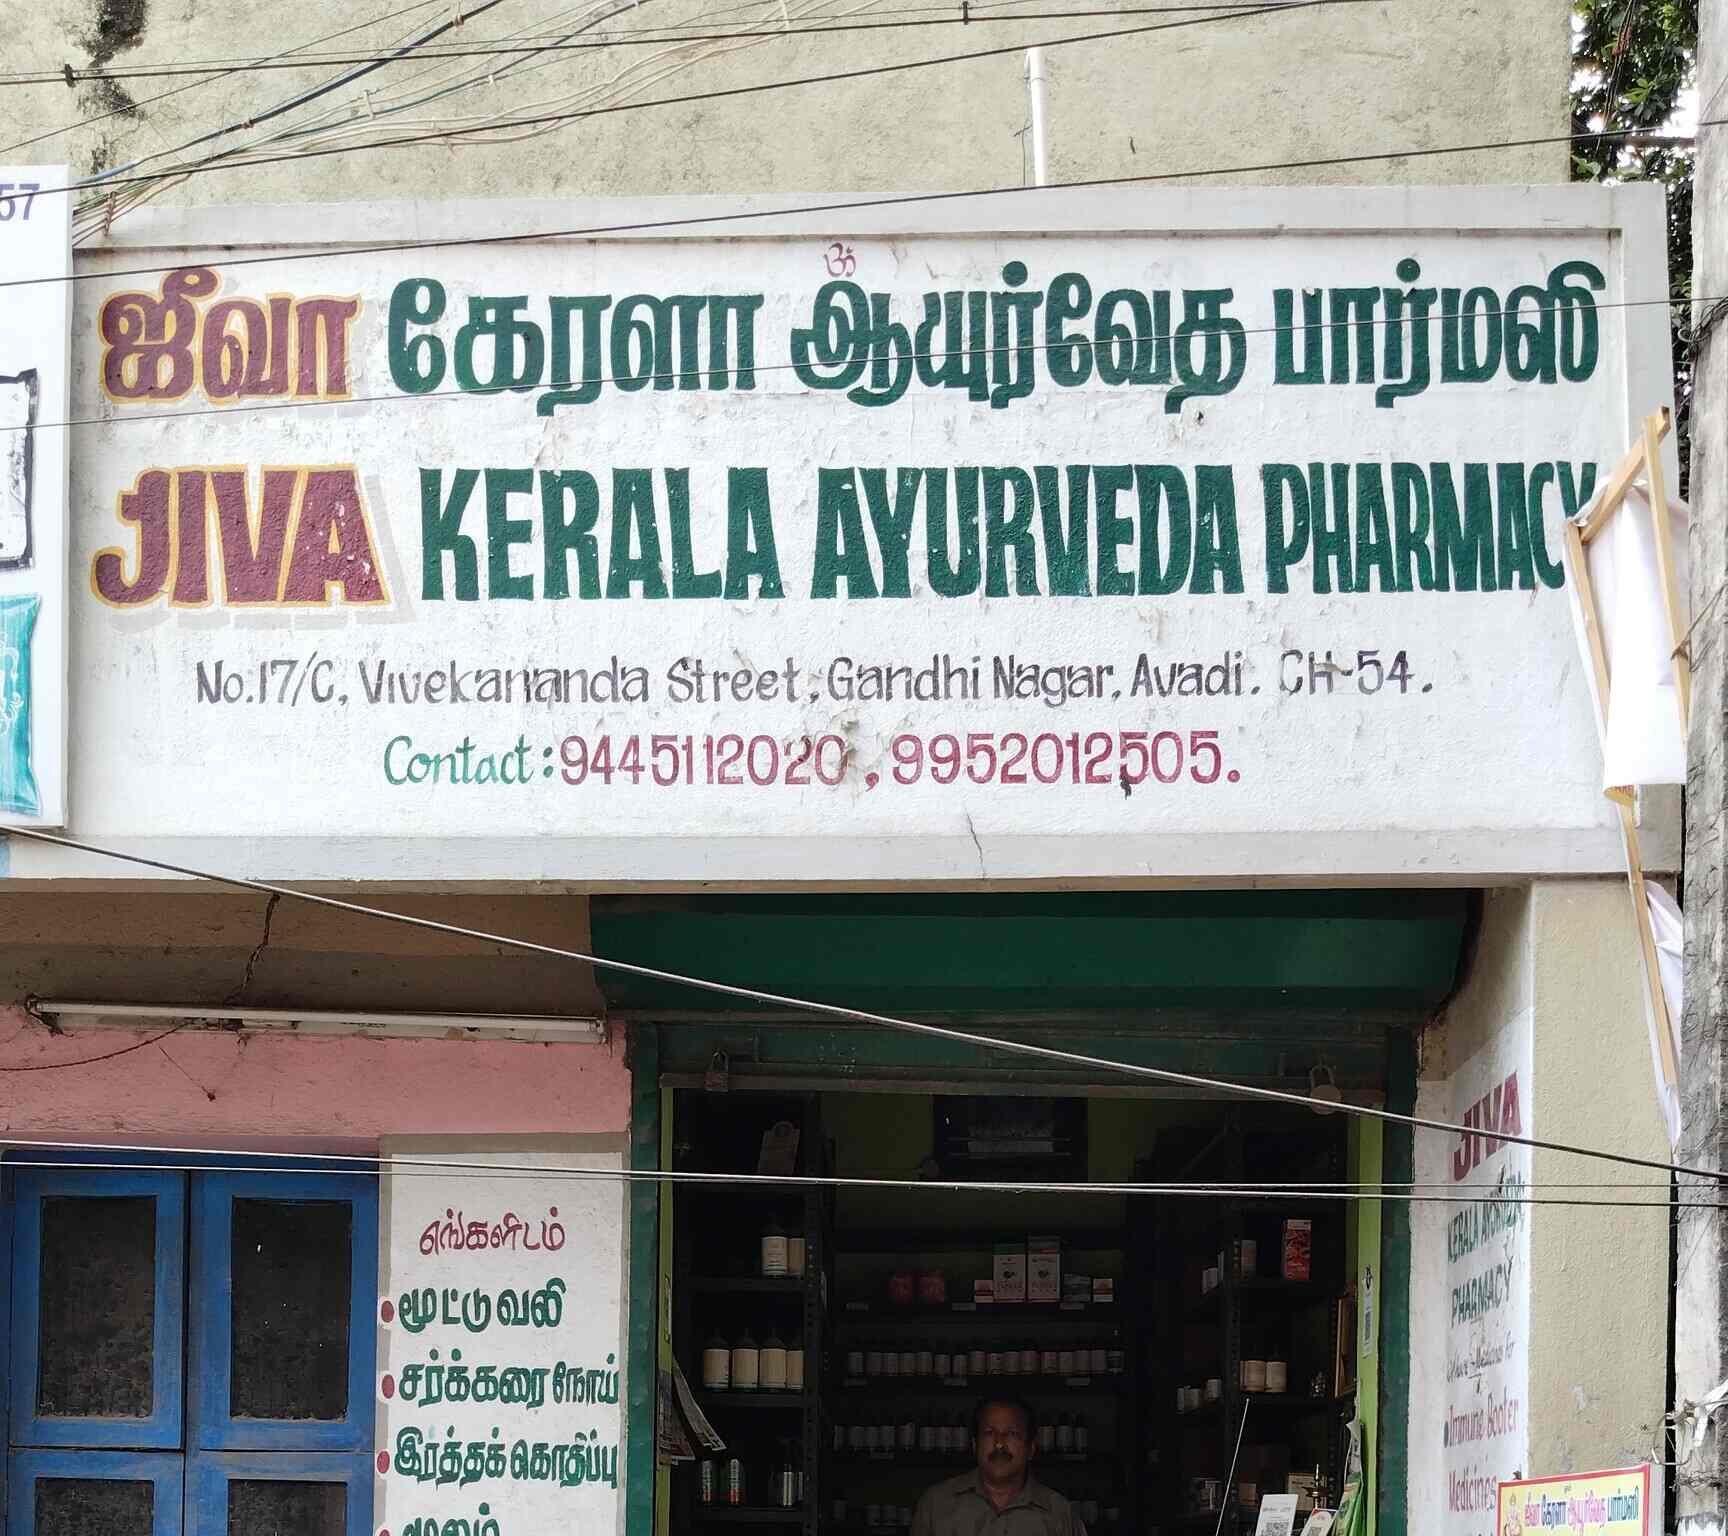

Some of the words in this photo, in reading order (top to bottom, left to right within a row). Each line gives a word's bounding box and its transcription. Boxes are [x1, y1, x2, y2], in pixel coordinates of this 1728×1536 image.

[99, 266, 363, 403] ஜீவா
[387, 277, 765, 417] கேரளா
[791, 260, 1246, 414] ஆயுர்வேத
[1273, 258, 1606, 409] பார்மஸி
[89, 462, 391, 607] JIVA
[419, 466, 786, 602] KERALA
[810, 464, 1245, 600] AYURVEDA
[1264, 460, 1598, 595] PHARMACY
[359, 656, 650, 706] Vivekananda
[827, 652, 980, 703] Gandhi
[992, 654, 1119, 708] Nagar,
[1453, 1072, 1522, 1182] JIVA
[419, 1206, 566, 1256] எங்களிடம்
[1452, 1255, 1513, 1328] PHARMACY
